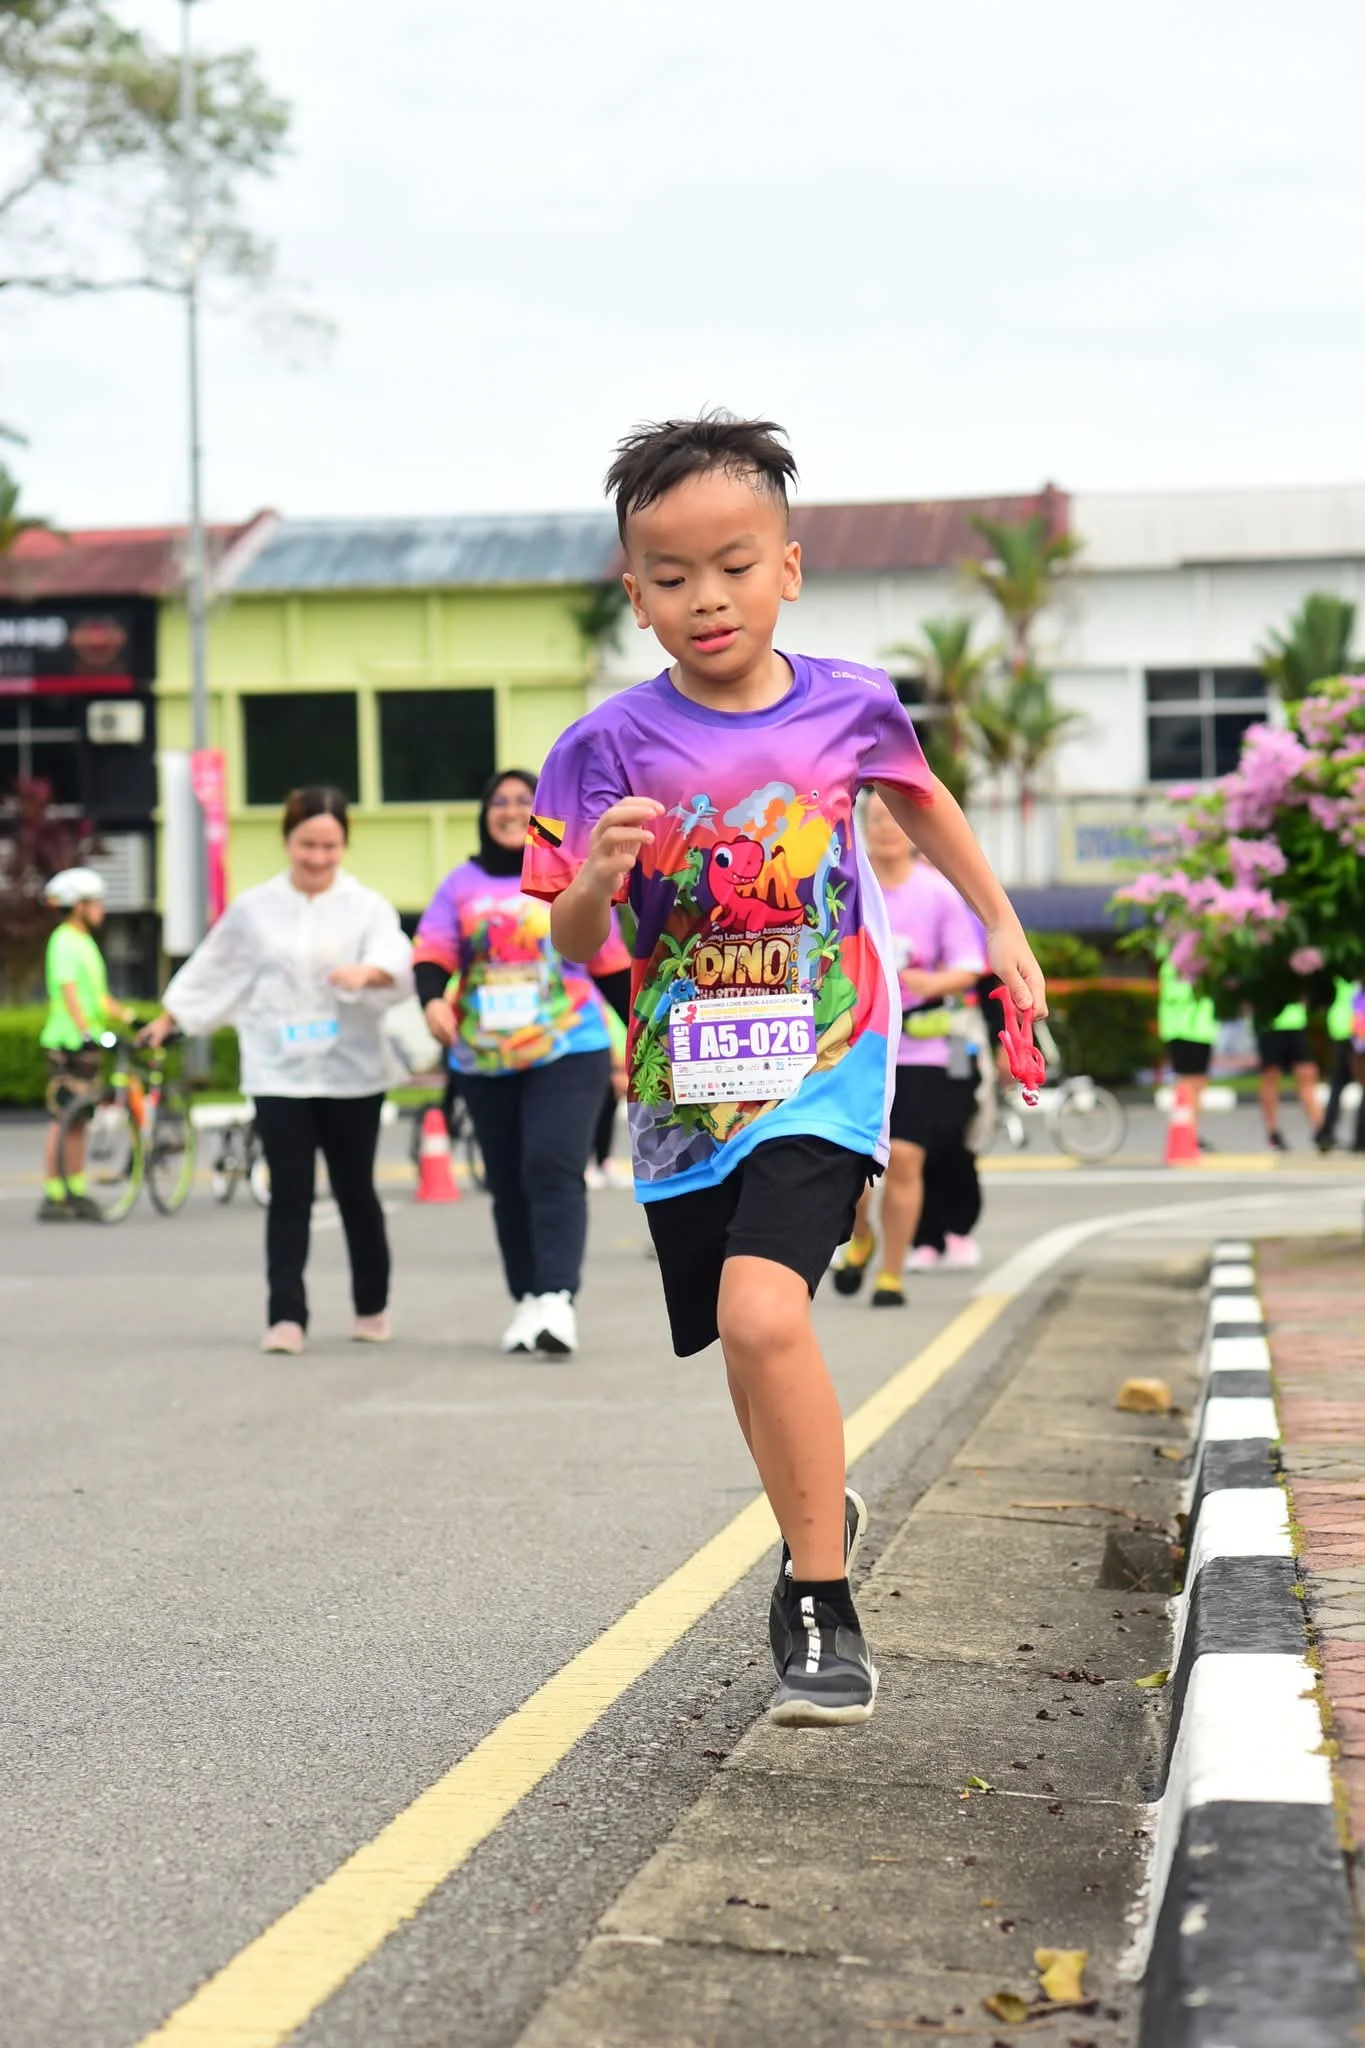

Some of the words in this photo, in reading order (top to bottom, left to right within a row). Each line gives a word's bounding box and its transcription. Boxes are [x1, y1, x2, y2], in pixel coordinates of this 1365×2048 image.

[696, 940, 790, 986] DINO
[673, 1025, 692, 1061] 5KM
[699, 1019, 809, 1059] A5-026
